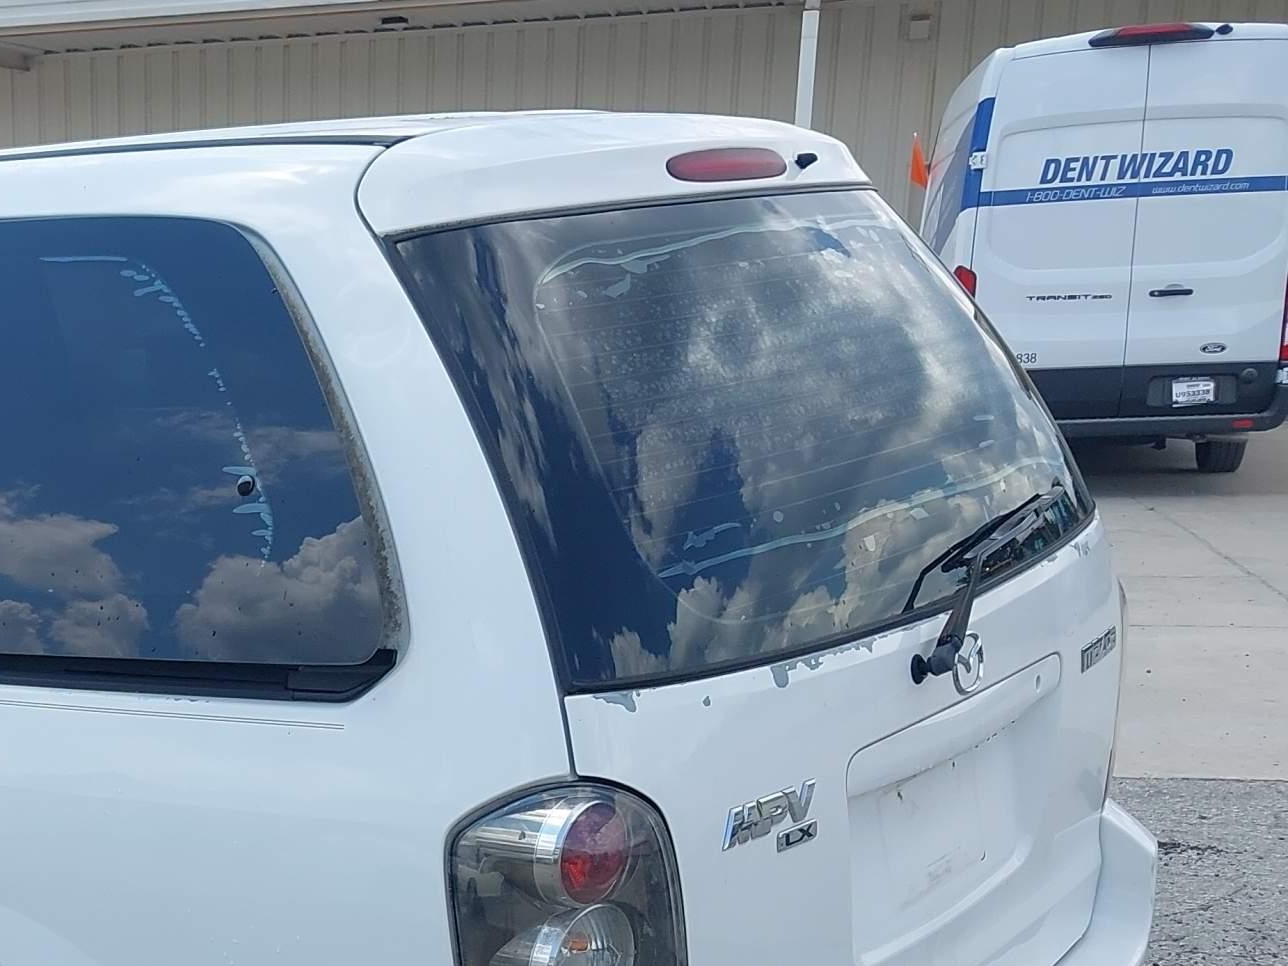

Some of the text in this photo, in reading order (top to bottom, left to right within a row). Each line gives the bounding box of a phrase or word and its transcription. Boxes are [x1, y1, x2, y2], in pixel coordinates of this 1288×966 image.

[1039, 148, 1234, 185] DENT WIZARD
[1026, 186, 1127, 202] 1-800-DENT-WIZ
[1152, 182, 1250, 194] www.dentwizard.com
[722, 778, 816, 852] MPV
[783, 821, 815, 848] LX
